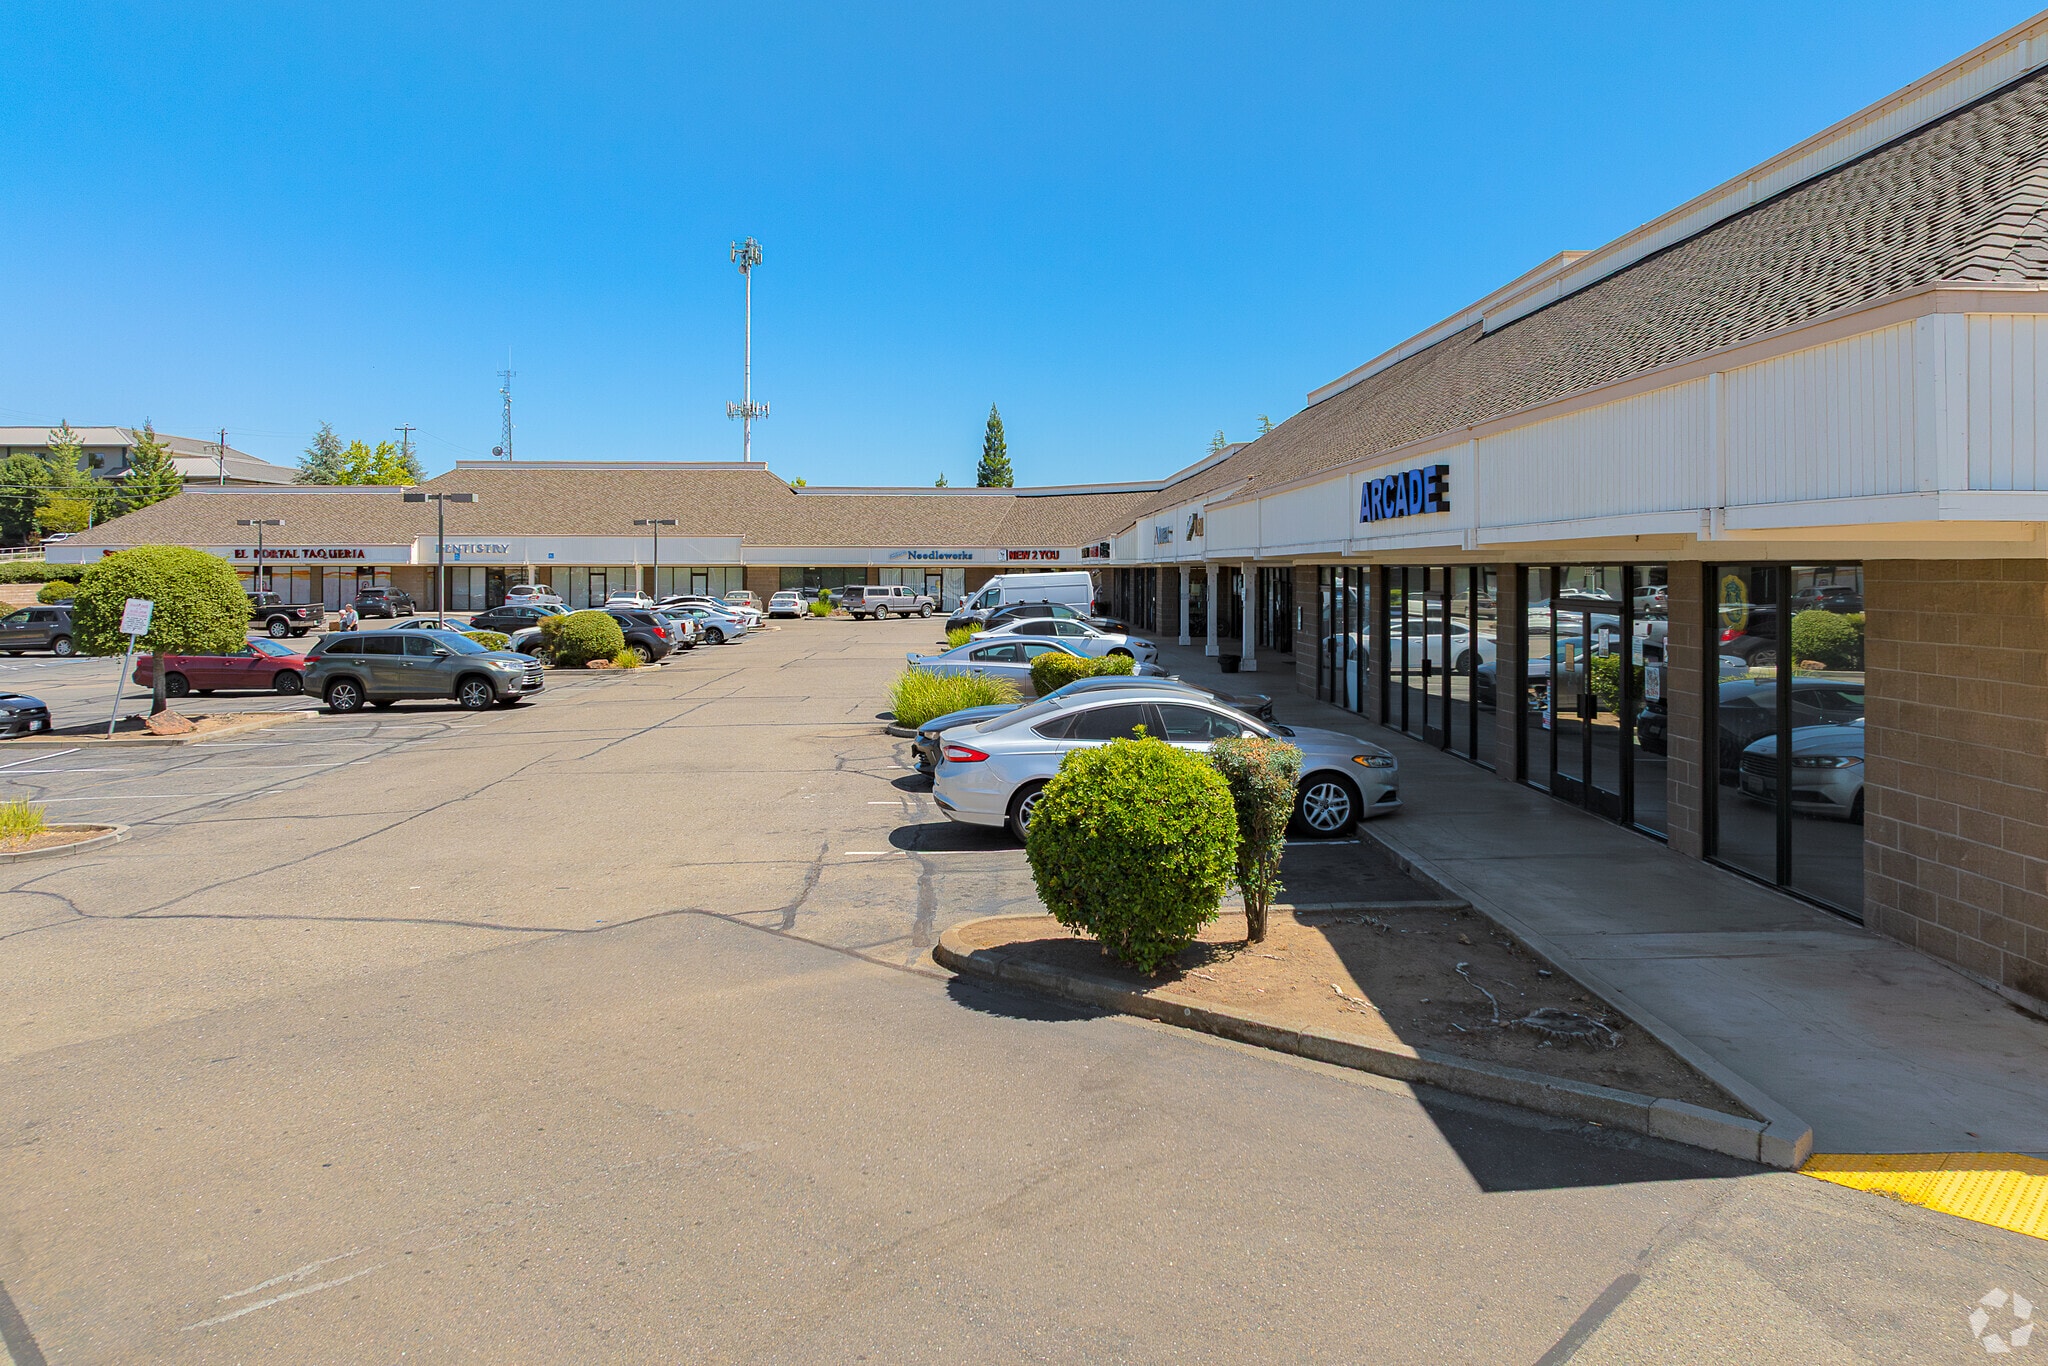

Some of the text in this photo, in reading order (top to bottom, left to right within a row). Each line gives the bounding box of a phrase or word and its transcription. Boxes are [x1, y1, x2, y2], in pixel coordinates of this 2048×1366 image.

[1360, 465, 1450, 523] ARCADE
[234, 549, 365, 559] EL PORTAL TAQUERIA
[908, 550, 973, 560] Needleworks
[1009, 550, 1060, 560] NEW 2 YOU
